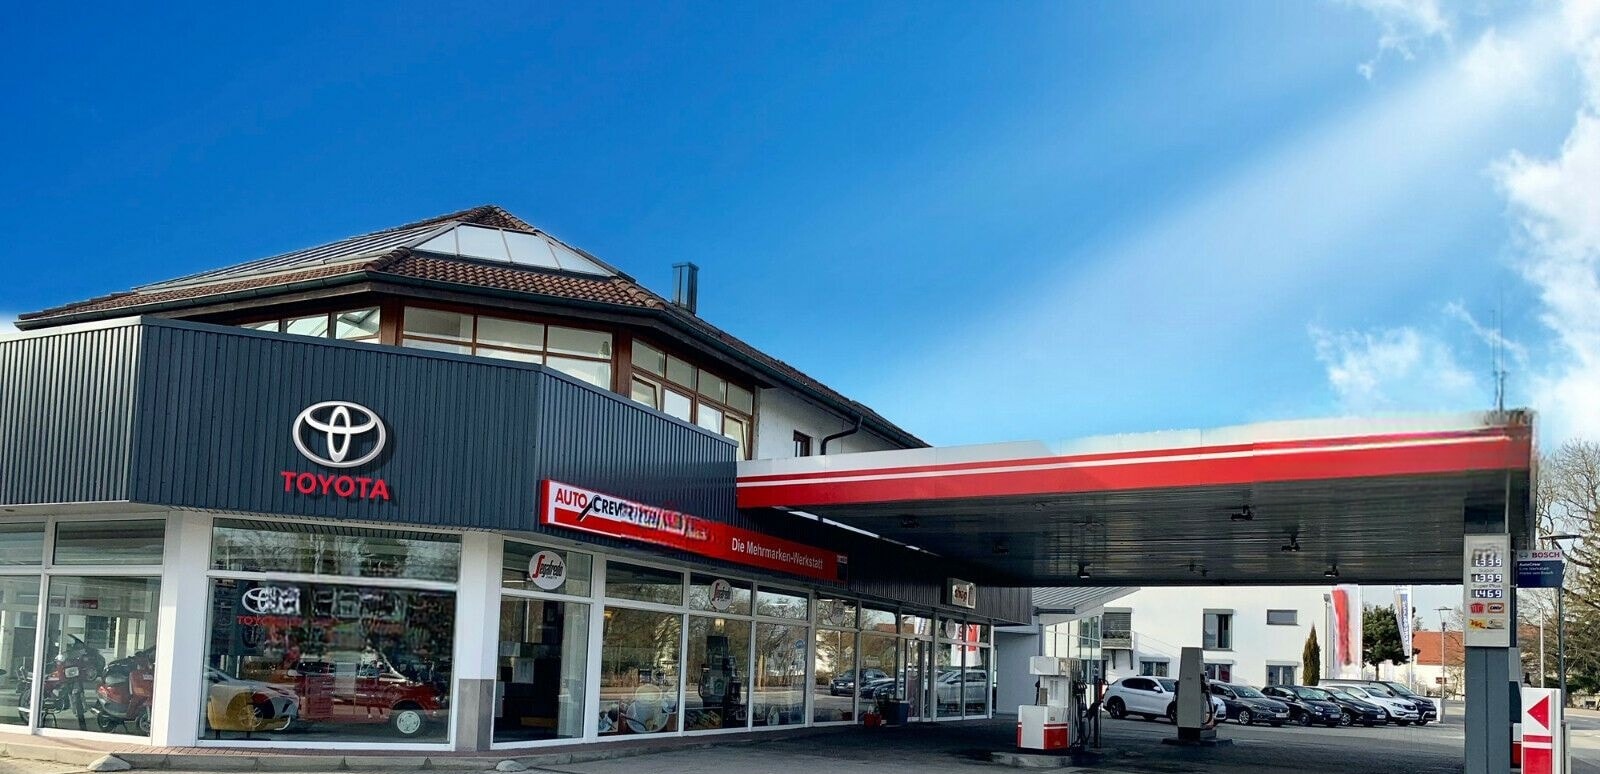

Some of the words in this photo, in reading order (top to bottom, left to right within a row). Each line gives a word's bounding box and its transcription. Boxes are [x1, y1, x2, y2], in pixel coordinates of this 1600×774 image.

[281, 472, 390, 500] TOYOTA
[555, 488, 588, 508] AUTO
[732, 537, 745, 553] Die
[746, 541, 824, 570] Mehrmarken-Werkstatt
[1475, 589, 1502, 598] 1.469
